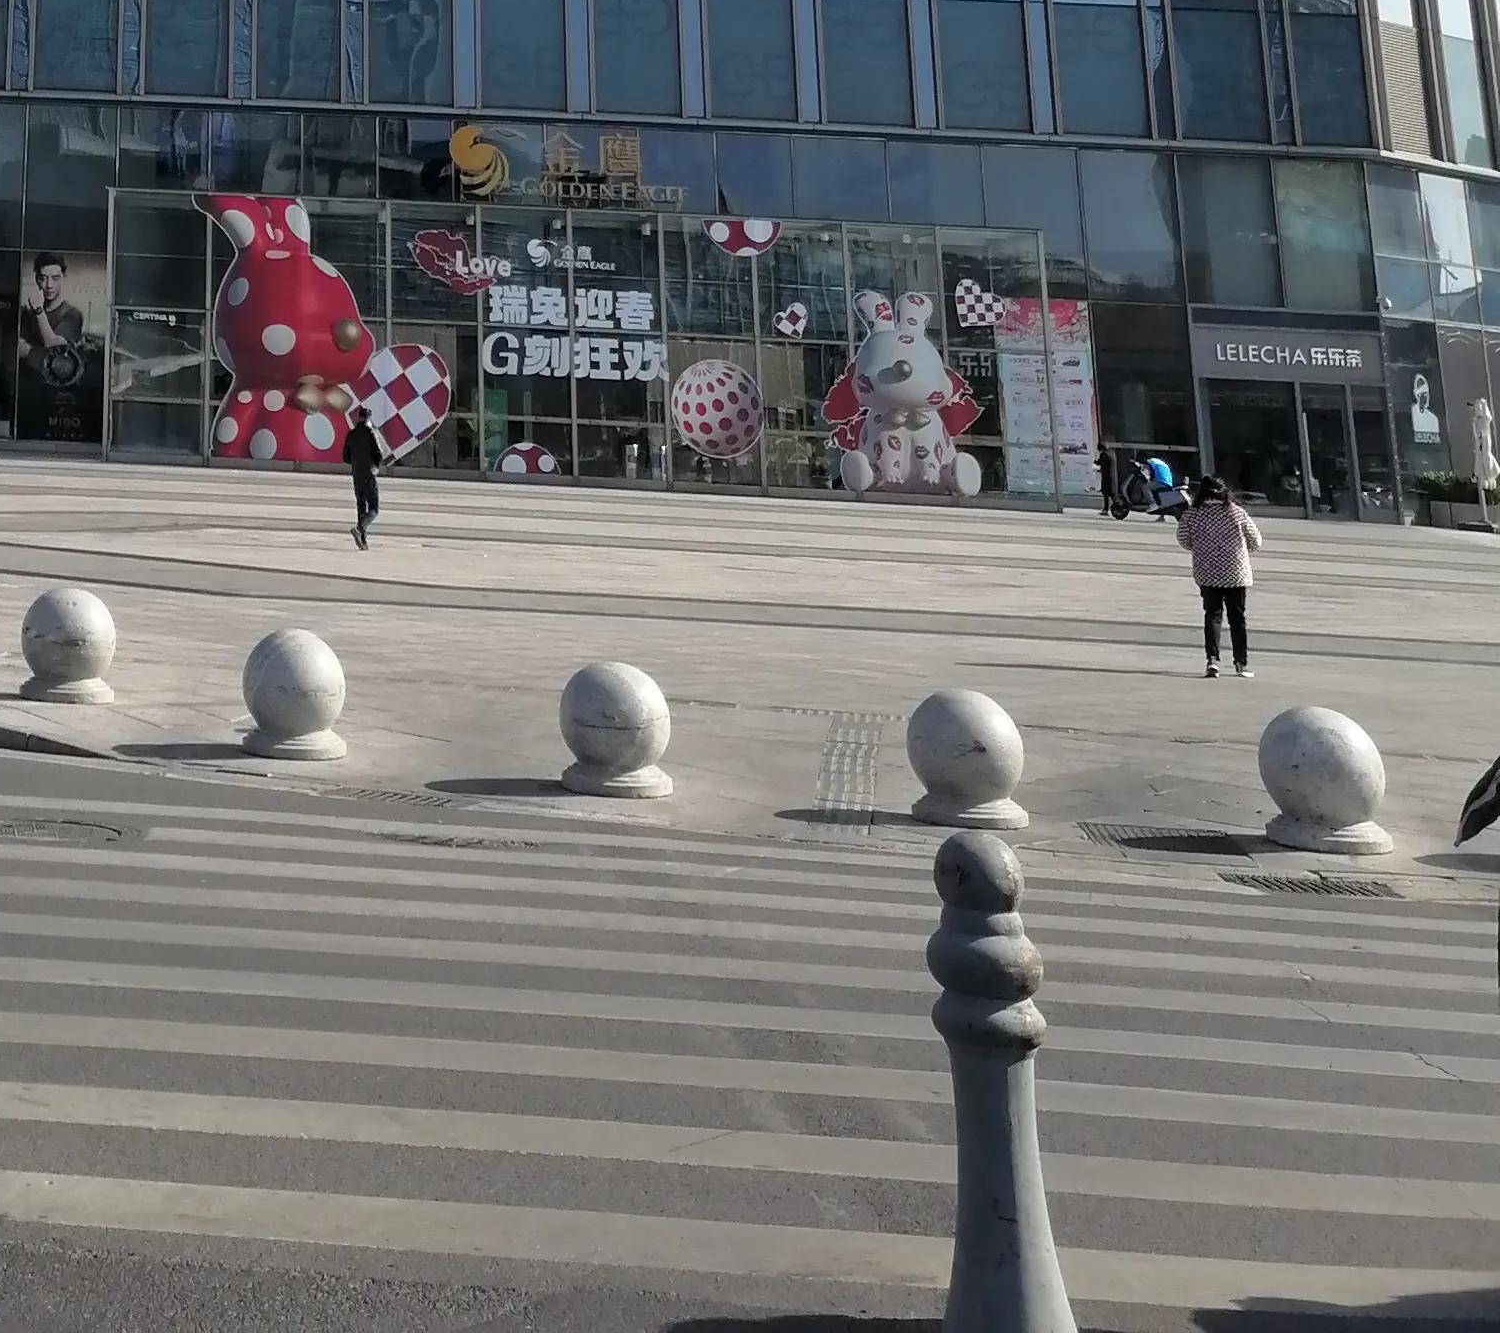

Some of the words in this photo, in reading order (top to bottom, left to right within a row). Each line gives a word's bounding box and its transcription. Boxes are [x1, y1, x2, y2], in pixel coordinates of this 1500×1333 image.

[544, 131, 640, 177] 金鹰
[521, 176, 619, 201] GOLDEN
[454, 250, 512, 277] Love
[488, 284, 655, 331] 瑞兔迎春
[482, 331, 670, 383] G刻狂欢
[1216, 343, 1307, 366] LELECHA
[1310, 347, 1363, 369] 乐乐茶
